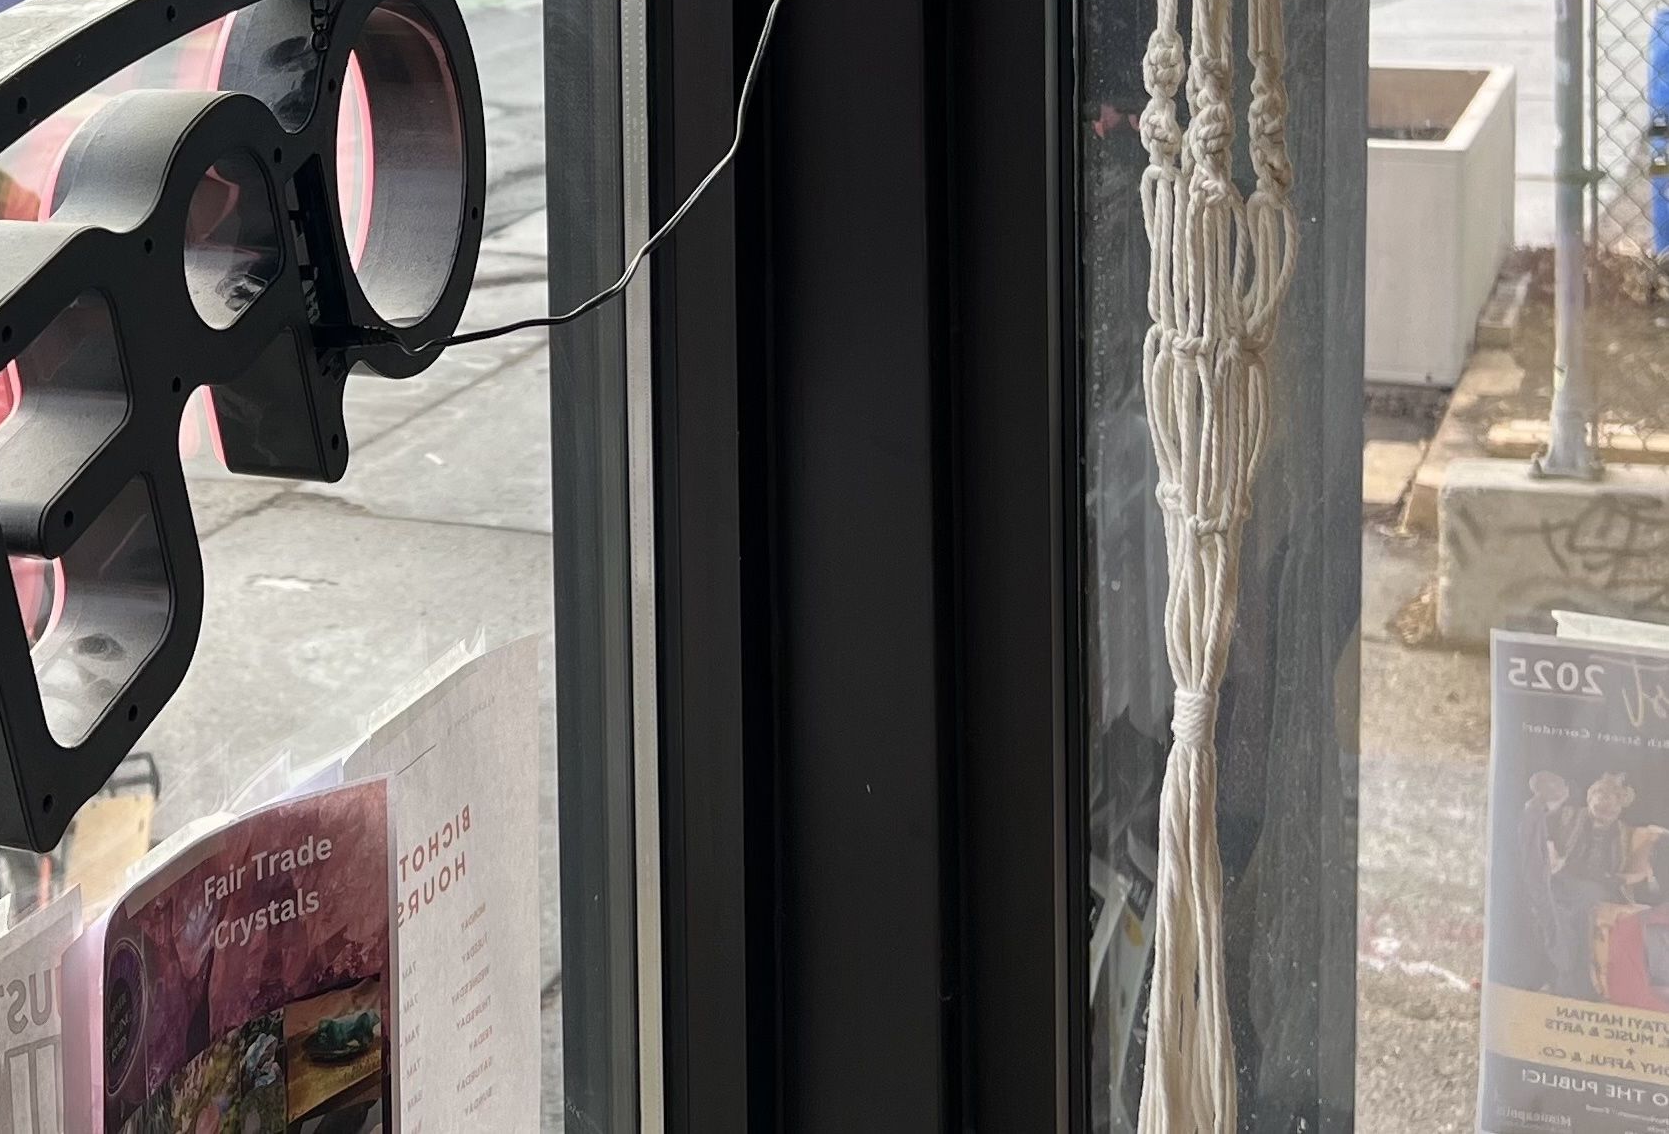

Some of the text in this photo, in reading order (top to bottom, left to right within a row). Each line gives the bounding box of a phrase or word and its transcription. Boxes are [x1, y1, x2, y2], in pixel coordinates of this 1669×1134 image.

[204, 835, 332, 908] Fair Trade
[214, 888, 320, 949] Crystals
